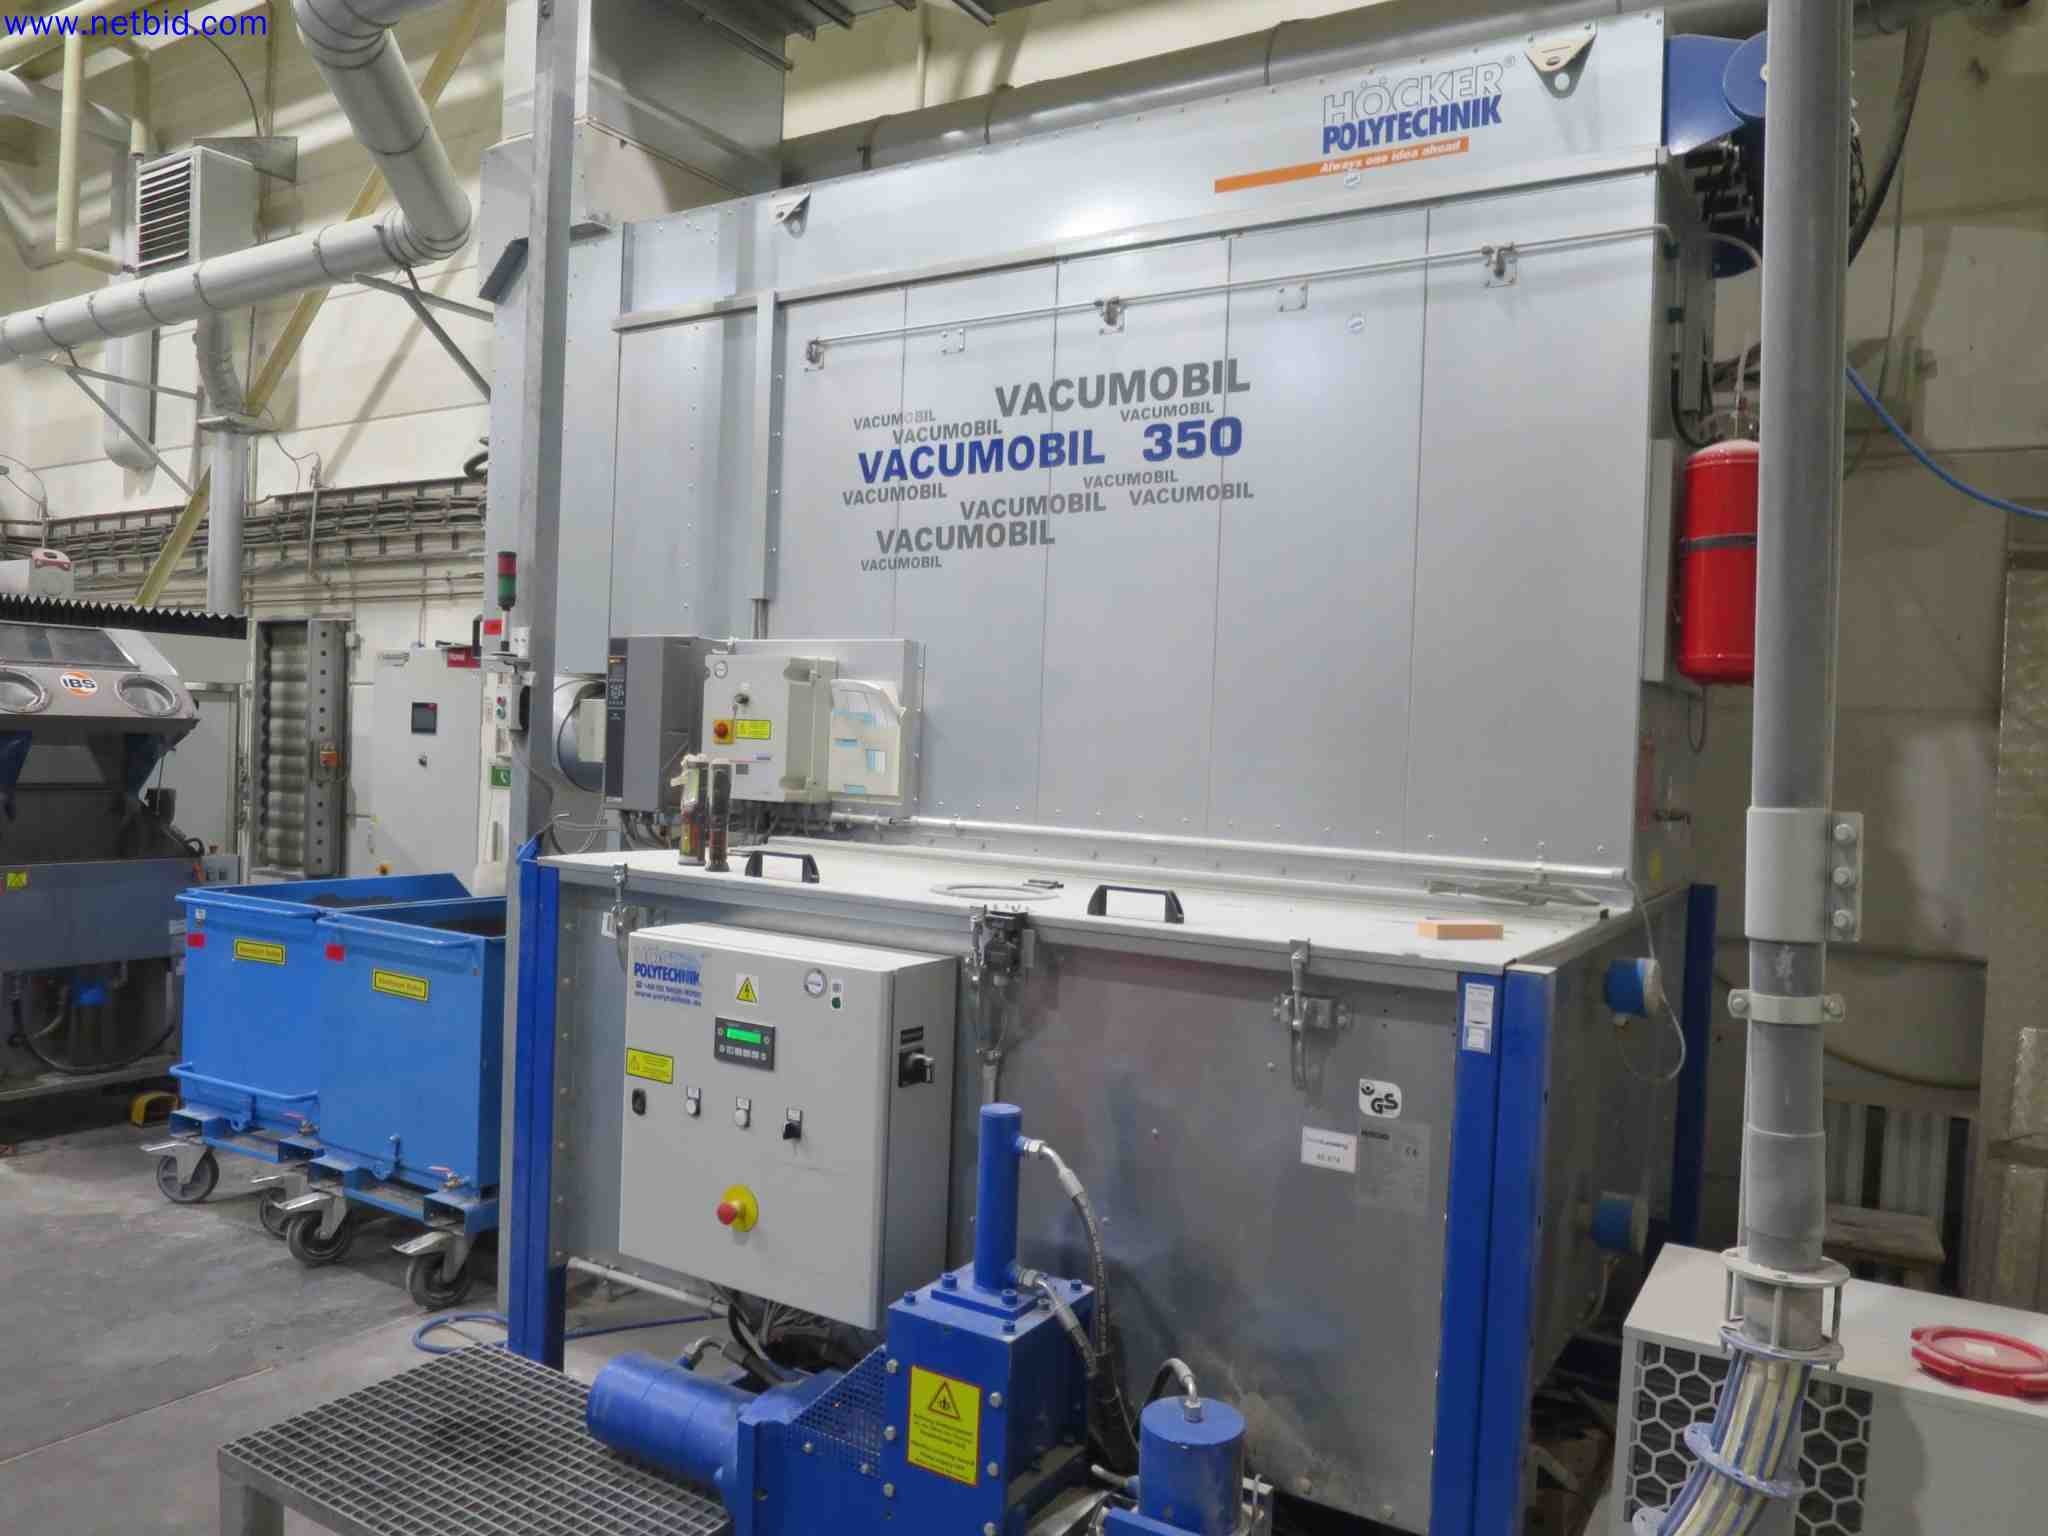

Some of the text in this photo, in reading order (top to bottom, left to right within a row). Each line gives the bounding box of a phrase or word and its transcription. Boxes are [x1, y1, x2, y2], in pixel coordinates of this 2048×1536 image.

[1322, 94, 1503, 155] POLYTECHNIK
[1320, 160, 1363, 174] Always
[995, 359, 1251, 418] VACUMOBIL
[853, 409, 936, 431] VACUMOBIL
[1120, 401, 1214, 422] VACUMOBIL
[892, 418, 1003, 444] VACUMOBIL
[858, 416, 1243, 484] VACUMOBIL 350
[1083, 469, 1178, 490] VACUMOBIL
[842, 482, 947, 507] VACUMOBIL
[1129, 482, 1254, 506] VACUMOBIL
[960, 492, 1106, 521] VACUMOBIL
[876, 519, 1055, 554] VACUMOBIL
[860, 555, 942, 572] VACUMOBIL
[63, 677, 96, 689] IBS
[1371, 1092, 1399, 1114] GS
